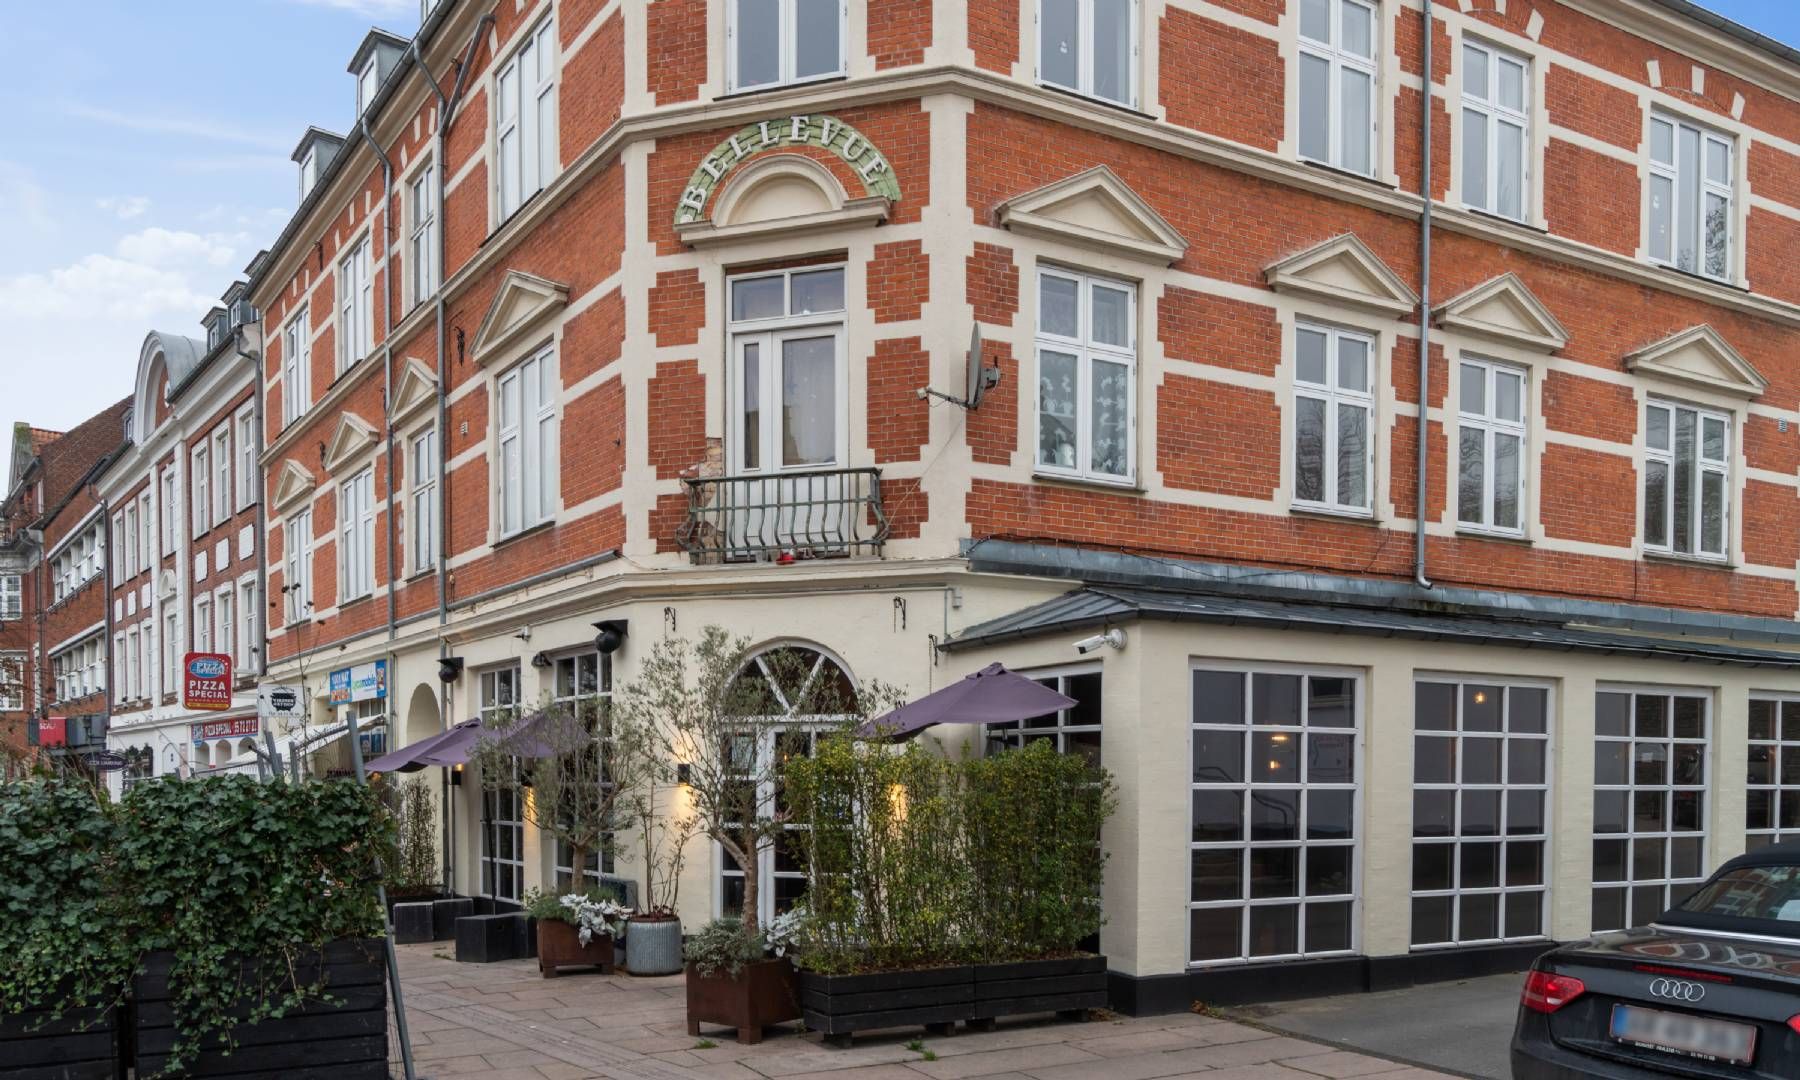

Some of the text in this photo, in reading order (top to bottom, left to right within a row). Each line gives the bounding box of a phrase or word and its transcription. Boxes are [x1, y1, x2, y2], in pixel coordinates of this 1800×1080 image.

[683, 116, 887, 213] BELLEVUE
[189, 680, 225, 690] PIZZA
[189, 690, 228, 698] SPECIAL
